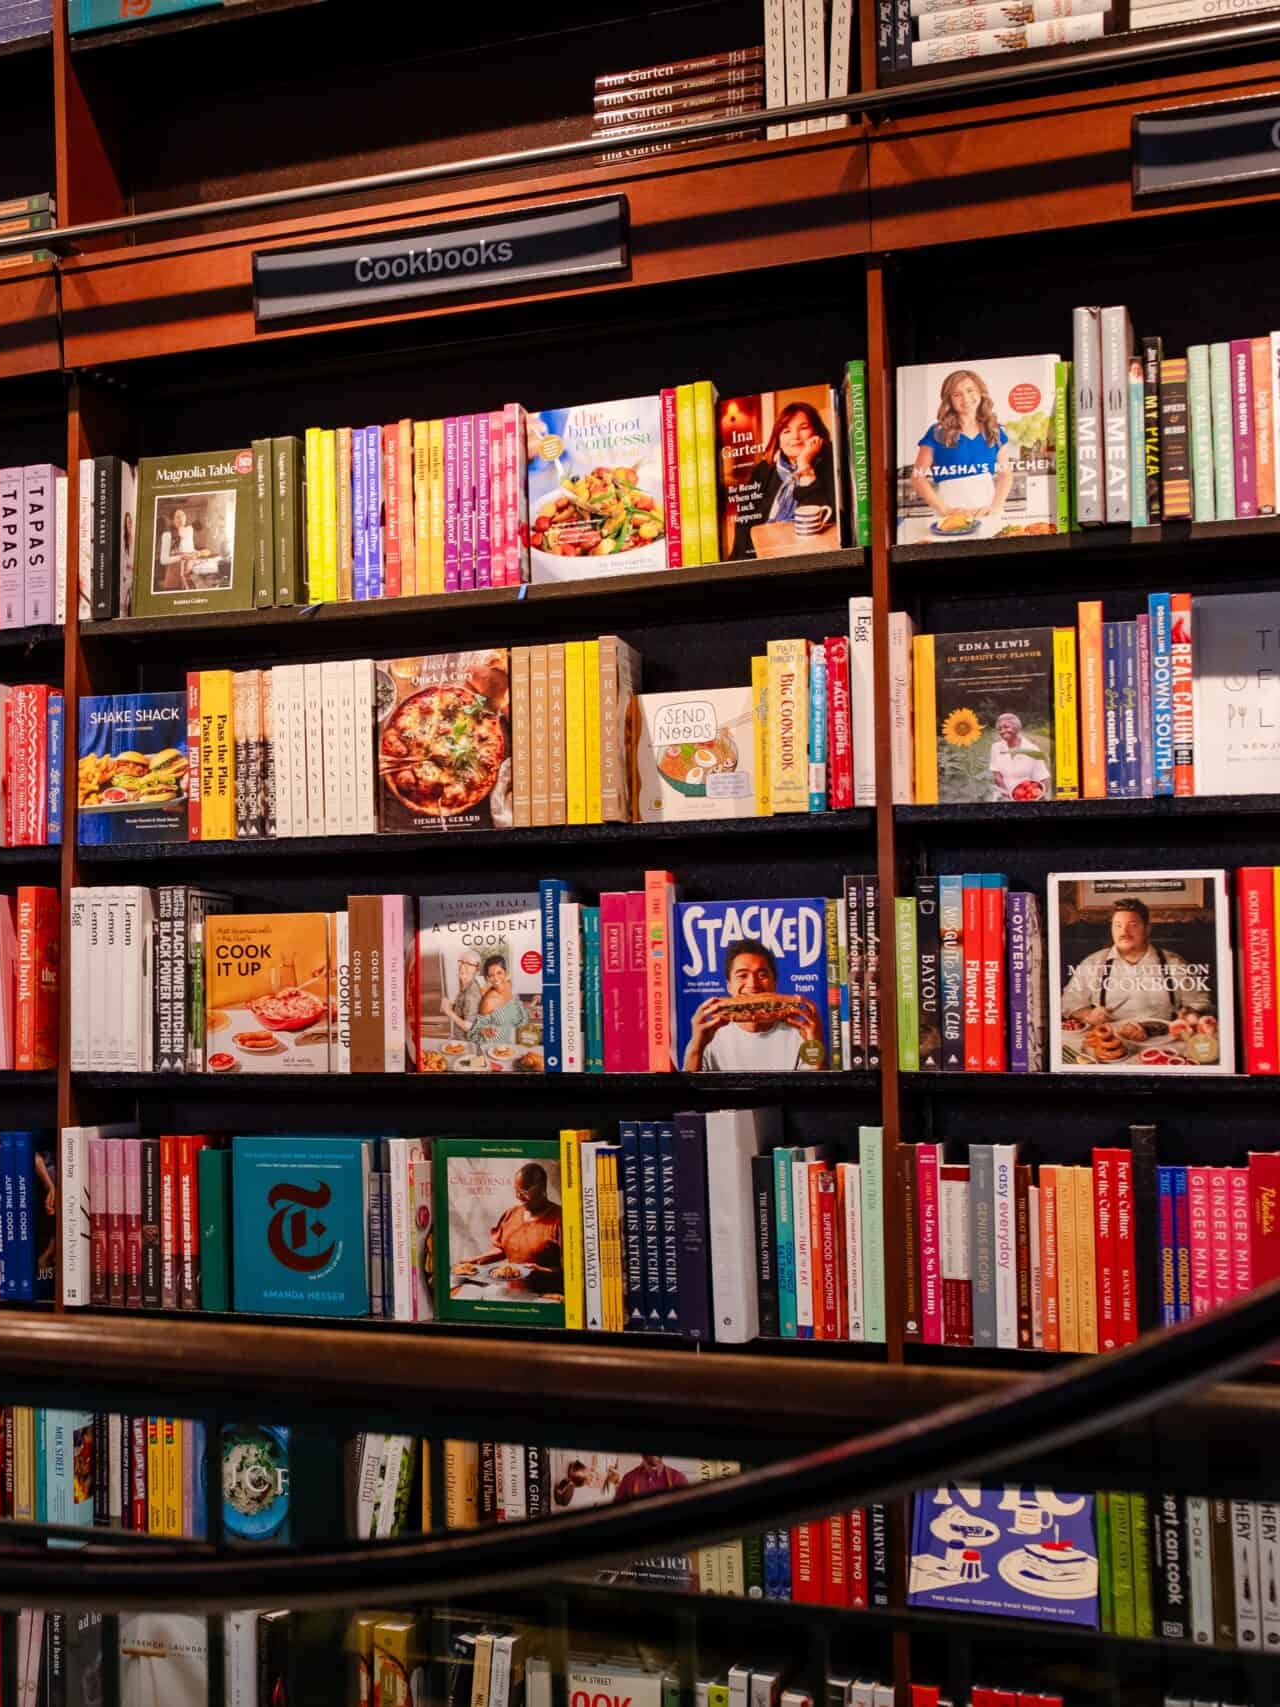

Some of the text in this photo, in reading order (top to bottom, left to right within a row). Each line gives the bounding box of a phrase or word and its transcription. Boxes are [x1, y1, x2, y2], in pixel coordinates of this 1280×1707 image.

[353, 236, 514, 284] Cookbooks
[569, 418, 641, 439] barefoot
[575, 432, 651, 450] contessa
[721, 442, 766, 458] Garten
[731, 431, 753, 443] Ina
[1145, 395, 1161, 477] MY PIZZA
[156, 463, 236, 482] Magnolia Table
[913, 462, 989, 477] NATASHA'S
[1078, 416, 1096, 500] MEAT
[1107, 416, 1126, 500] MEAT
[28, 485, 45, 567] TAPAS
[736, 502, 755, 512] Luck
[1, 488, 18, 570] TAPAS
[855, 615, 871, 643] Egg
[958, 639, 1031, 652] EDNA LEWIS
[1154, 656, 1173, 770] DOWN SOUTH
[1171, 643, 1193, 745] REAL CAJUN
[90, 708, 179, 724] SHAKE SHACK
[604, 680, 613, 784] HARVEST
[659, 724, 712, 740] NOODS
[664, 709, 706, 724] SEND
[780, 673, 795, 772] BIG COOKBOOK
[536, 688, 544, 798] HARVEST
[71, 903, 86, 927] Egg
[91, 903, 102, 946] Lemon
[108, 903, 119, 946] Lemon
[124, 903, 136, 946] Lemon
[216, 944, 272, 959] COOK
[461, 934, 507, 946] COOK
[682, 904, 821, 977] STACKED
[41, 967, 57, 982] the
[160, 920, 172, 1053] BLACK POWER KITCHEN
[173, 920, 185, 1053] BLACK POWER KITCHEN
[217, 962, 261, 976] IT UP
[790, 974, 818, 982] owen
[795, 984, 815, 993] han
[921, 953, 937, 1014] BAYOU
[1068, 976, 1211, 992] A COOKBOOK
[965, 959, 980, 1025] Flavor+Us
[984, 959, 1000, 1025] Flavor+Us
[585, 1187, 600, 1289] SIMPLY TOMATO
[996, 1164, 1012, 1269] easy everyday
[1192, 1175, 1209, 1290] GINGER MINJ
[1212, 1175, 1229, 1290] GINGER MINJ
[1233, 1175, 1249, 1290] GINGER MINJ
[55, 1425, 63, 1446] MILK
[363, 1456, 380, 1503] Fruitful
[854, 1561, 862, 1580] TWO
[1164, 1531, 1184, 1605] can cook
